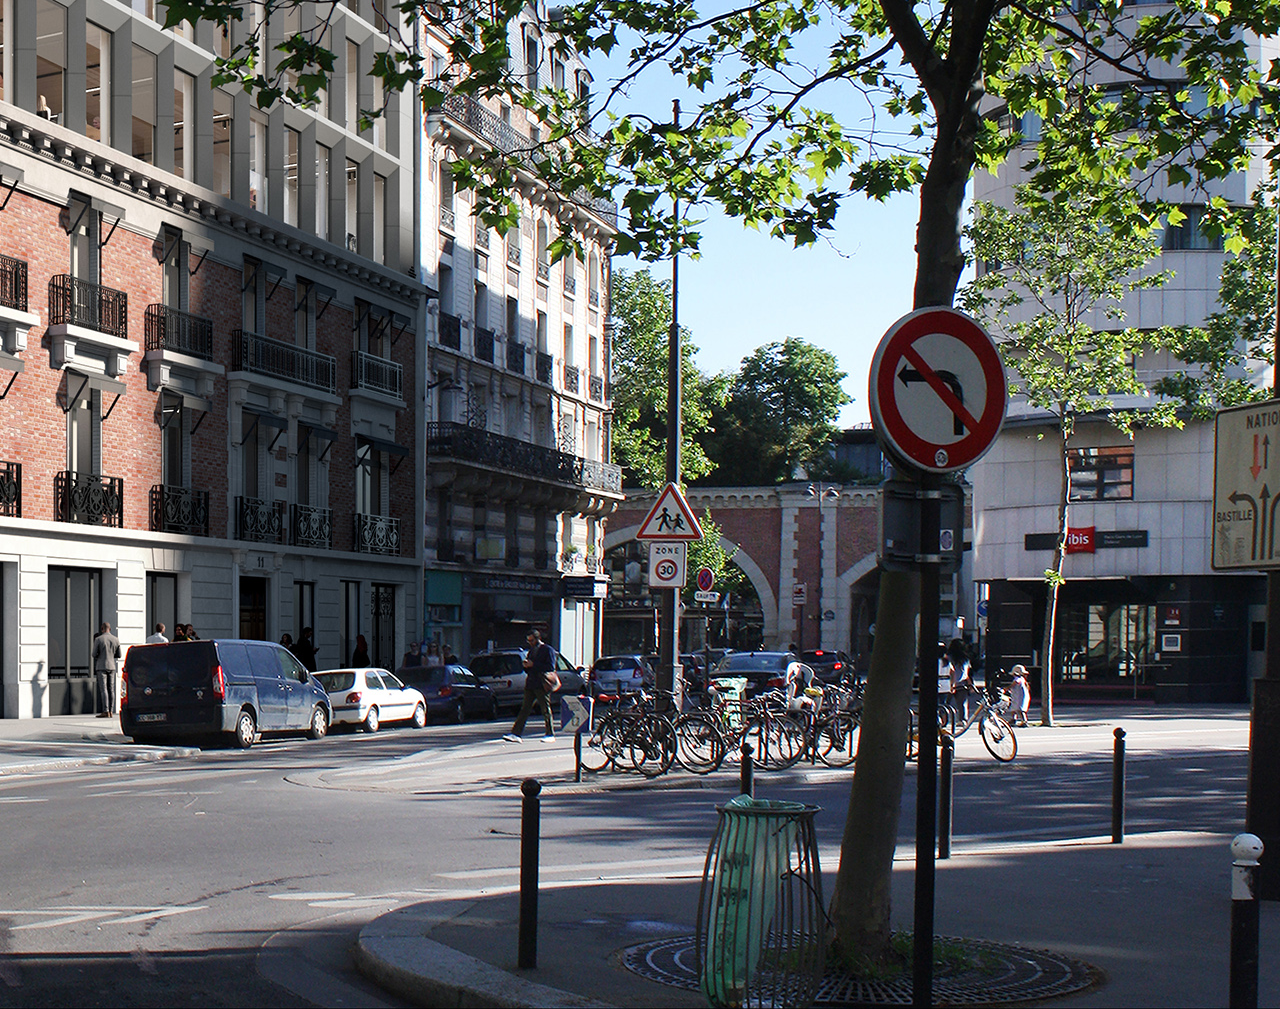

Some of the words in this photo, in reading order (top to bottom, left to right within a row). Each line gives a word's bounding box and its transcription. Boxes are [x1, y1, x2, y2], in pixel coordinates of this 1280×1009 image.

[1246, 410, 1280, 429] NATIO
[1217, 509, 1252, 522] BASTILLE
[1068, 533, 1089, 545] ibis
[257, 557, 264, 568] 11
[660, 565, 673, 575] 30
